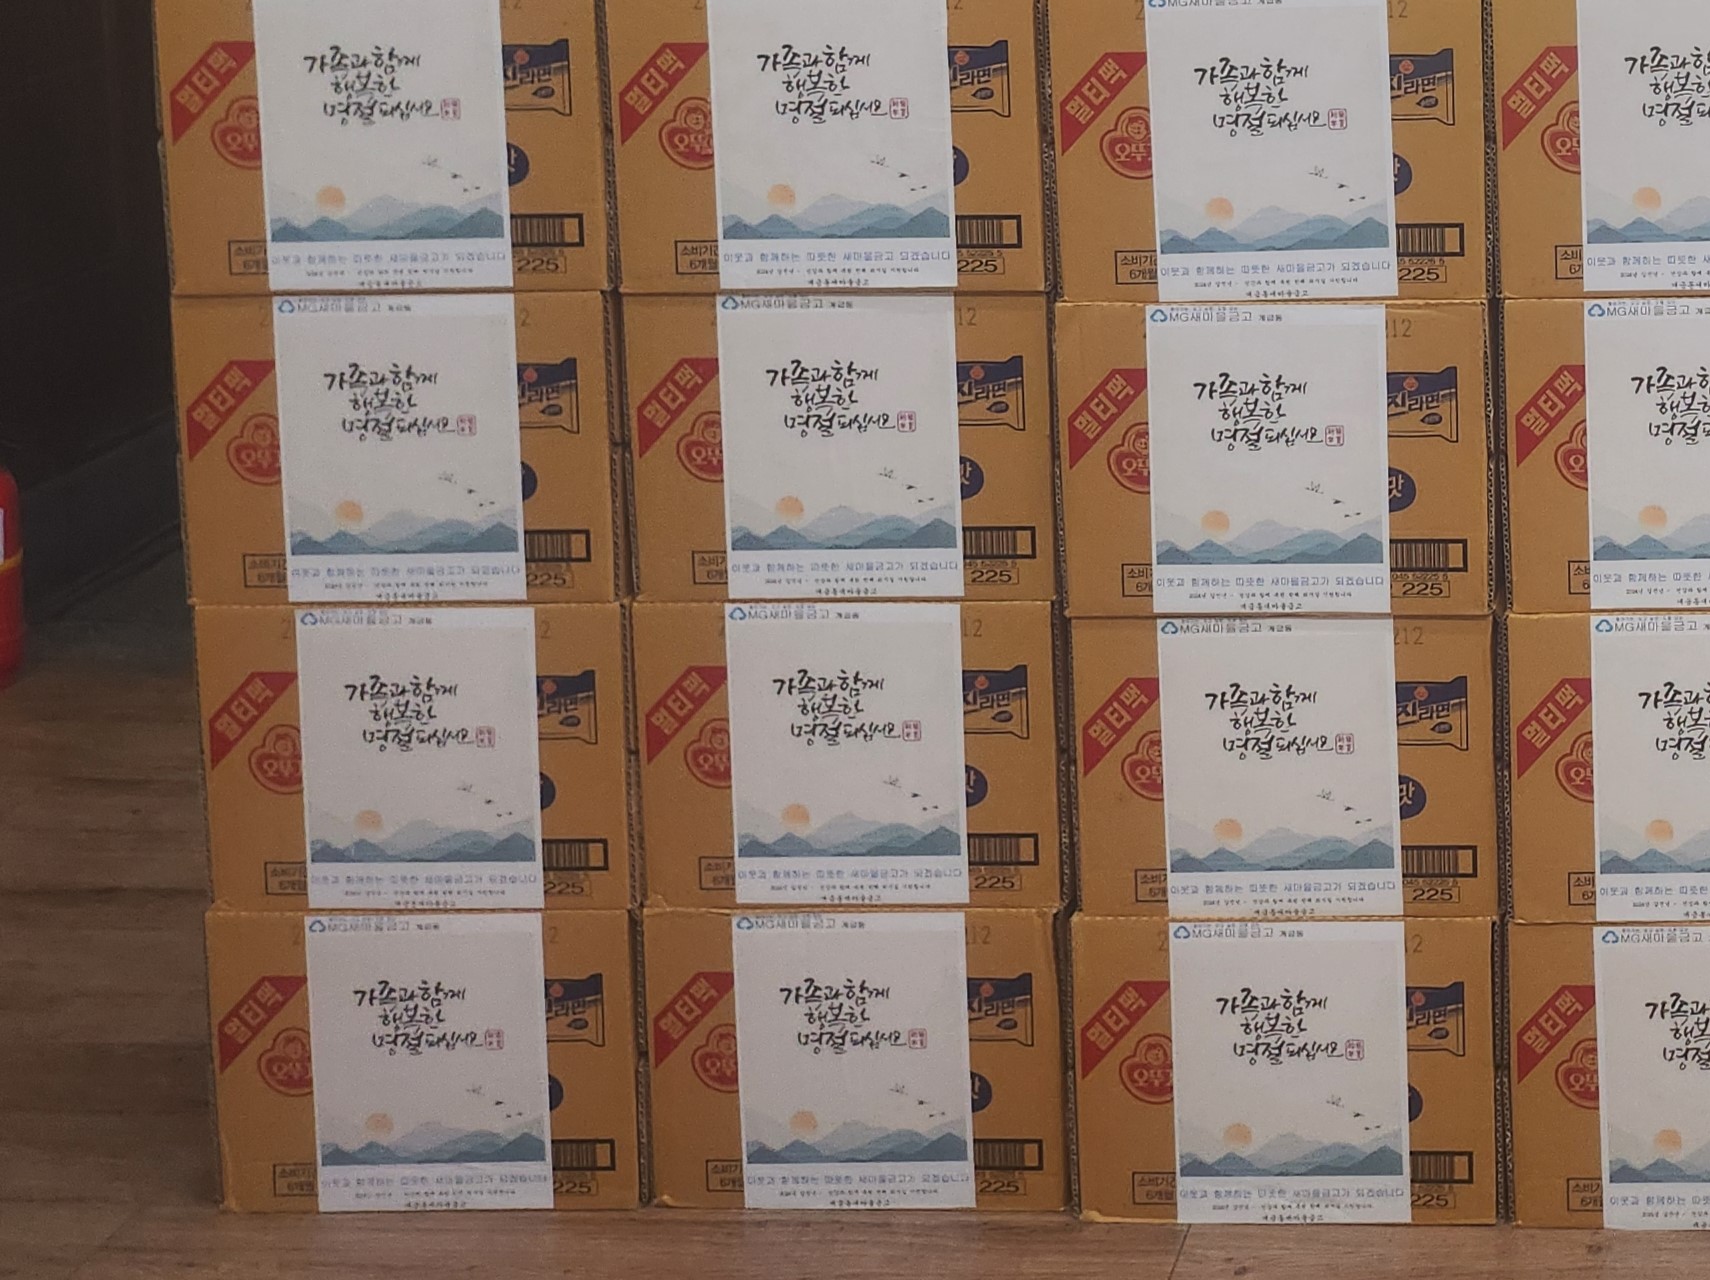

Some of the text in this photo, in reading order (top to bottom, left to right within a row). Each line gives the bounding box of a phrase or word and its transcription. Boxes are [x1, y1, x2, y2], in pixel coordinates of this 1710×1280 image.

[330, 71, 400, 100] 행복한
[782, 70, 850, 98] 행복한
[1067, 57, 1128, 123] 멀티팩
[1219, 81, 1288, 111] 행복한
[1509, 52, 1569, 117] 멀티팩
[956, 259, 996, 272] 225
[1397, 267, 1439, 281] 225
[349, 388, 417, 416] 행복한
[790, 384, 858, 412] 행복한
[1075, 373, 1135, 438] 멀티팩
[1218, 398, 1287, 426] 행복한
[1523, 370, 1583, 435] 멀티팩
[970, 569, 1011, 583] 225
[370, 700, 437, 727] 행복한
[797, 693, 864, 721] 행복한
[1090, 682, 1149, 746] 멀티팩
[1229, 707, 1297, 735] 행복한
[974, 876, 1013, 889] 225
[1411, 887, 1453, 901] 225
[379, 1004, 446, 1031] 행복한
[804, 1002, 870, 1029] 행복한
[1240, 1012, 1308, 1040] 행복한
[1525, 989, 1584, 1053] 멀티팩
[978, 1180, 1018, 1193] 225
[1408, 1193, 1448, 1206] 225
